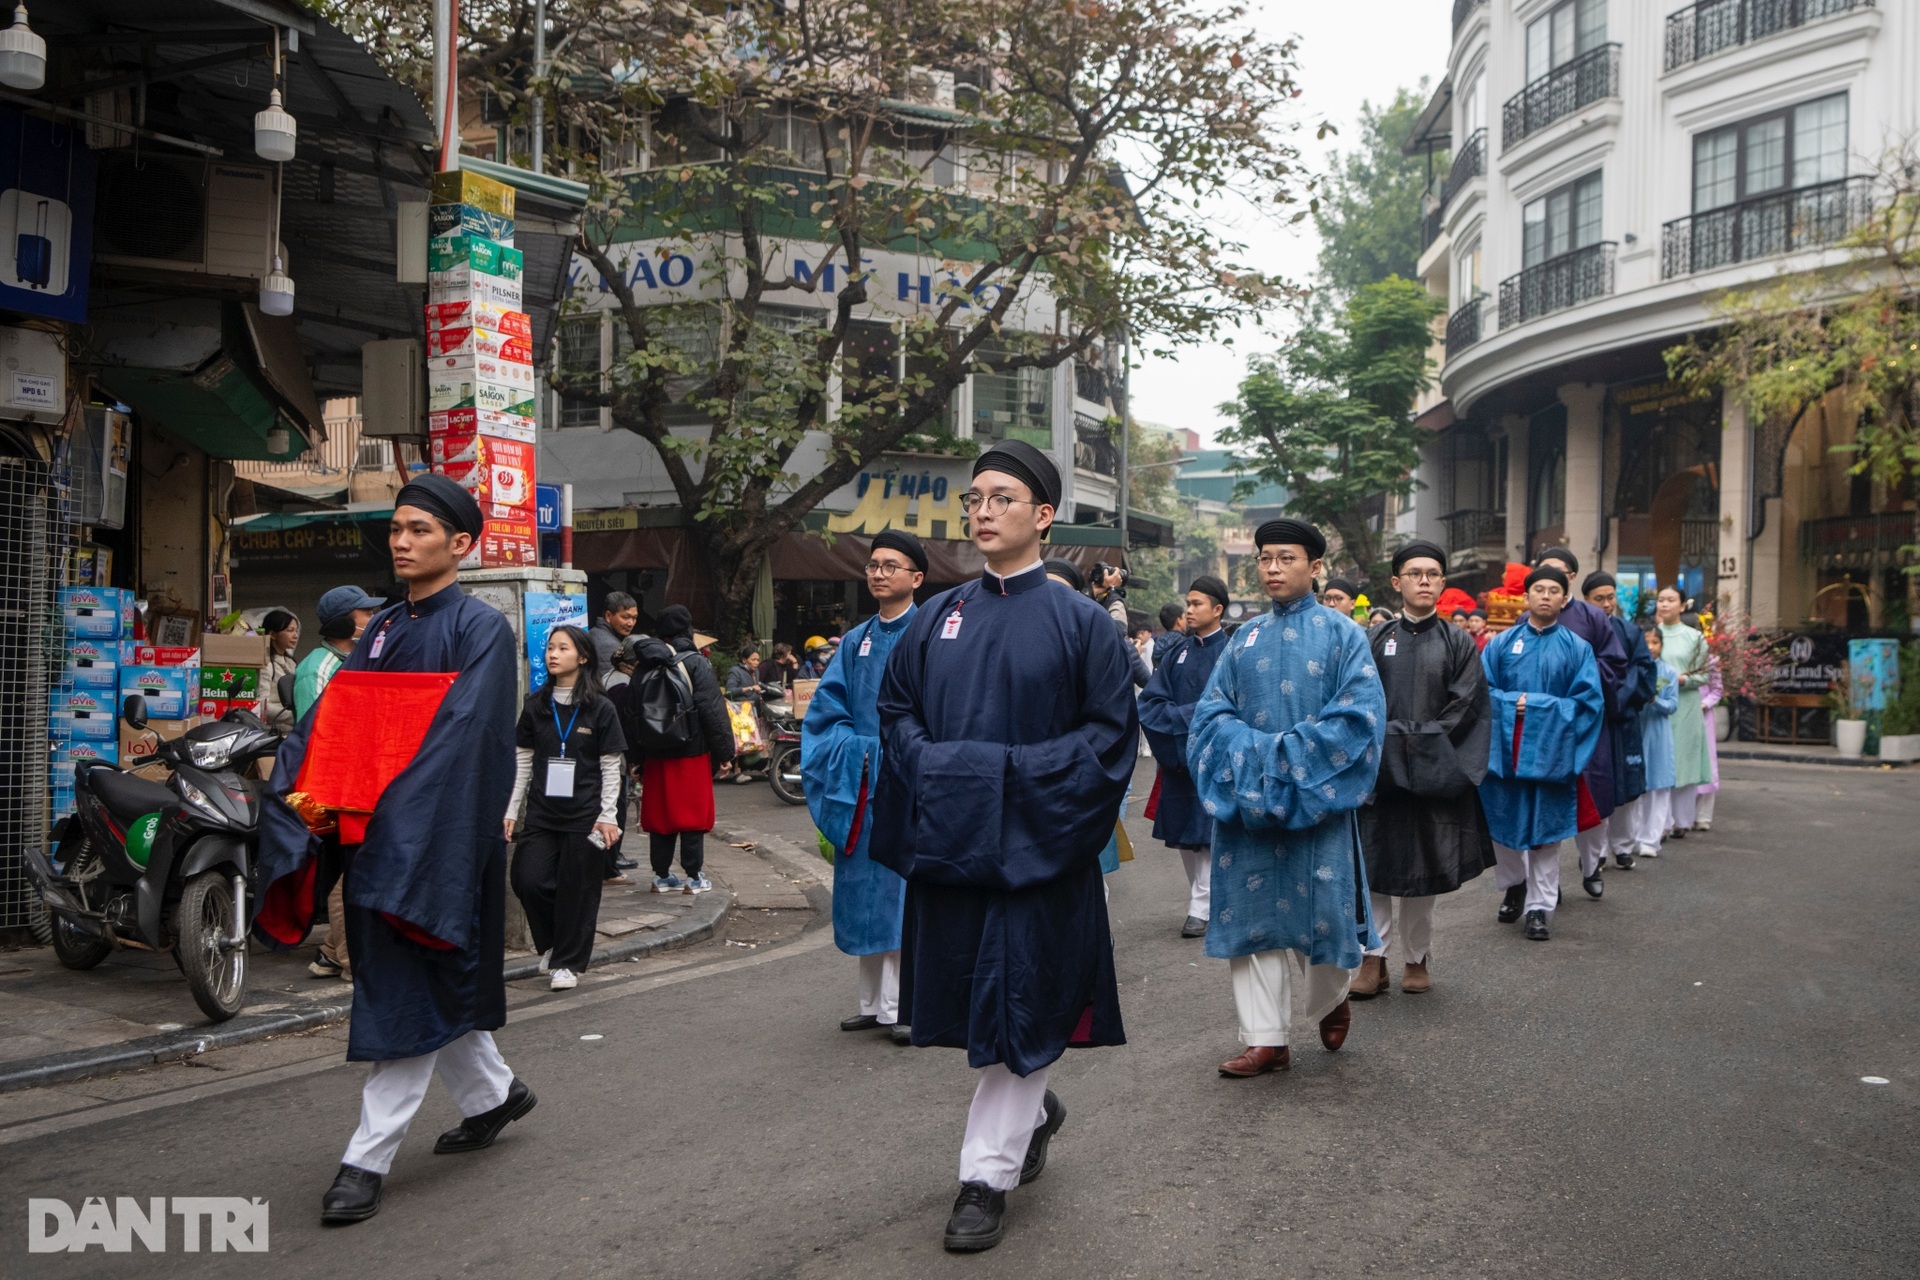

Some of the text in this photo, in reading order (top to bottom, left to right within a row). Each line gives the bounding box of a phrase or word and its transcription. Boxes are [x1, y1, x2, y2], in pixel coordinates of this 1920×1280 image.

[492, 286, 520, 300] PILSNER
[479, 388, 505, 402] SAIGON
[482, 399, 502, 408] LAGER
[1722, 558, 1736, 572] 13
[558, 606, 583, 614] NHANH
[1792, 664, 1822, 678] Land
[143, 818, 158, 839] Grab
